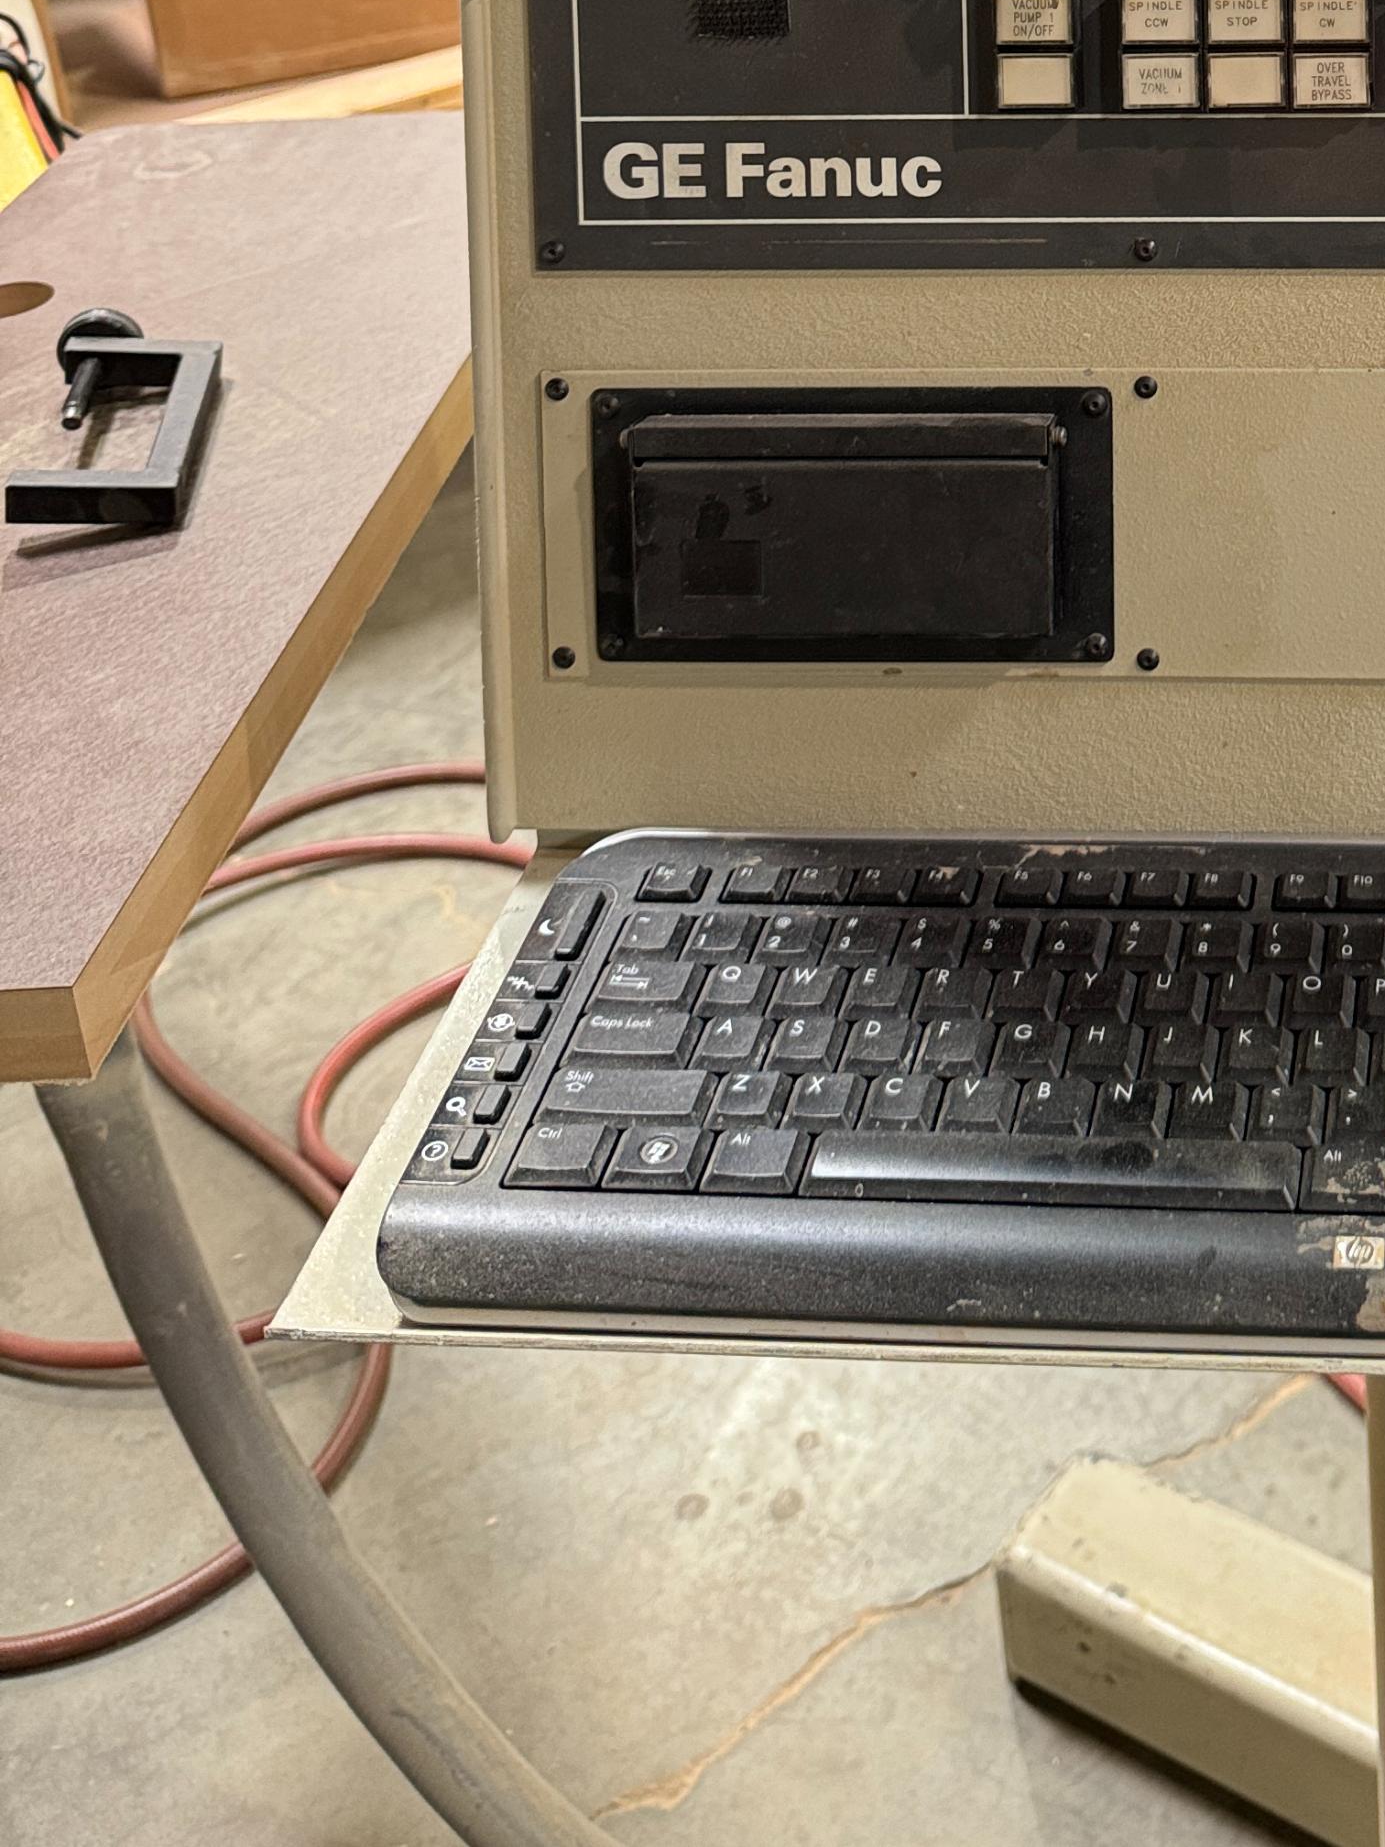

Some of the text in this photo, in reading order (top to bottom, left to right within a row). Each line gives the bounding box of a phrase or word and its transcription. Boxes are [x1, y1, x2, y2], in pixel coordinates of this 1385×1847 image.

[1128, 1, 1183, 12] SPINDLE
[1215, 0, 1269, 11] SPINDLE
[1300, 0, 1355, 12] SPINDLE
[1013, 12, 1042, 24] PUMP
[1144, 17, 1169, 29] CCW
[1227, 16, 1258, 27] STOP
[1319, 17, 1336, 29] CW
[1013, 24, 1054, 37] ON/OFF
[1317, 62, 1345, 74] OVER
[1139, 68, 1183, 81] VACUUM
[1311, 75, 1352, 88] TRAVEL
[1311, 89, 1352, 102] BYPASS
[602, 141, 943, 200] GE Fanuc
[616, 964, 639, 974] Tab
[591, 1015, 652, 1028] Caps Lock
[566, 1071, 593, 1082] Shift
